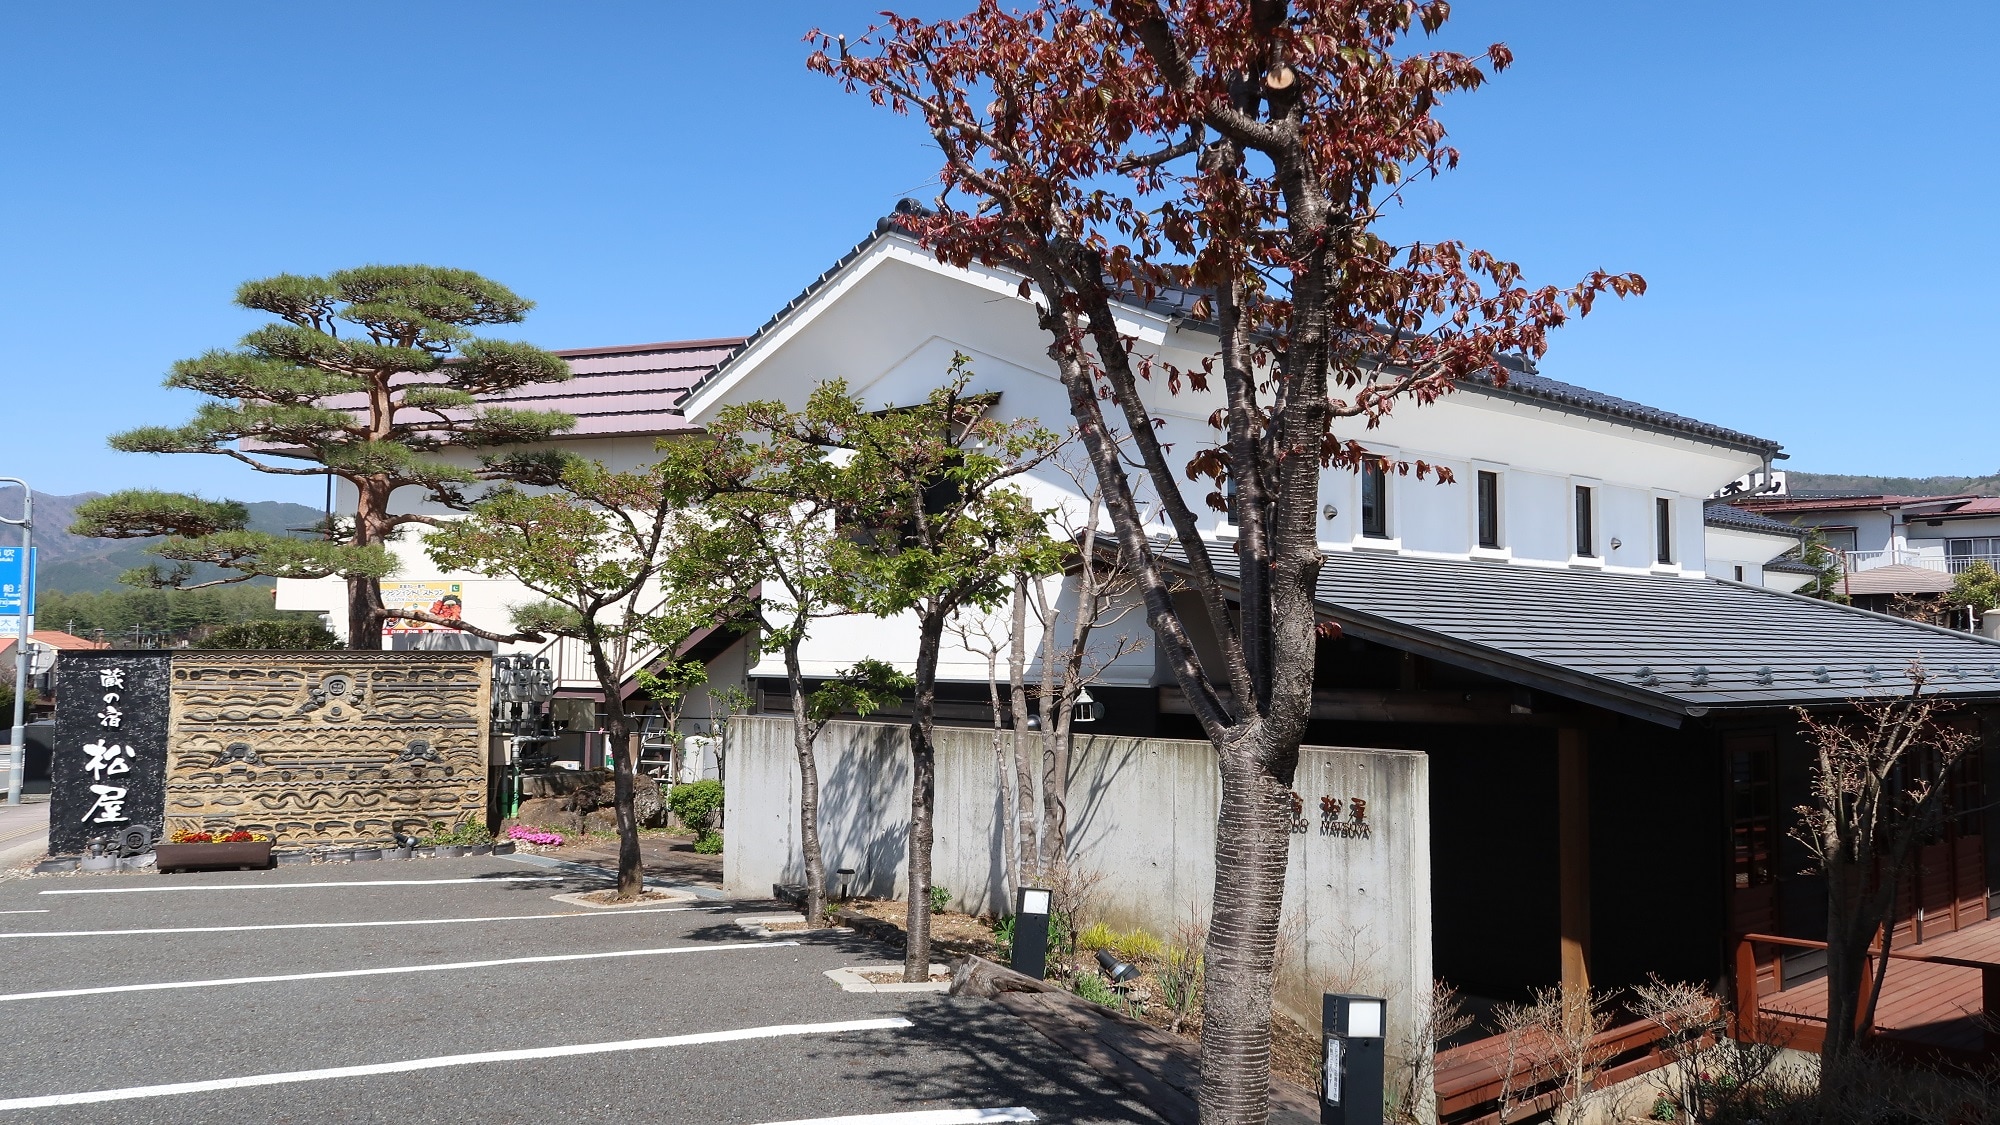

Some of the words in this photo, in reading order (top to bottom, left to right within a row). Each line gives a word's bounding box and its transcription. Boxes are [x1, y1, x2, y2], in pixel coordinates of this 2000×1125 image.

[97, 667, 126, 728] 蔵の宿
[81, 738, 136, 824] 松屋
[1320, 795, 1367, 820] 松屋
[1320, 820, 1372, 835] MATSUYA
